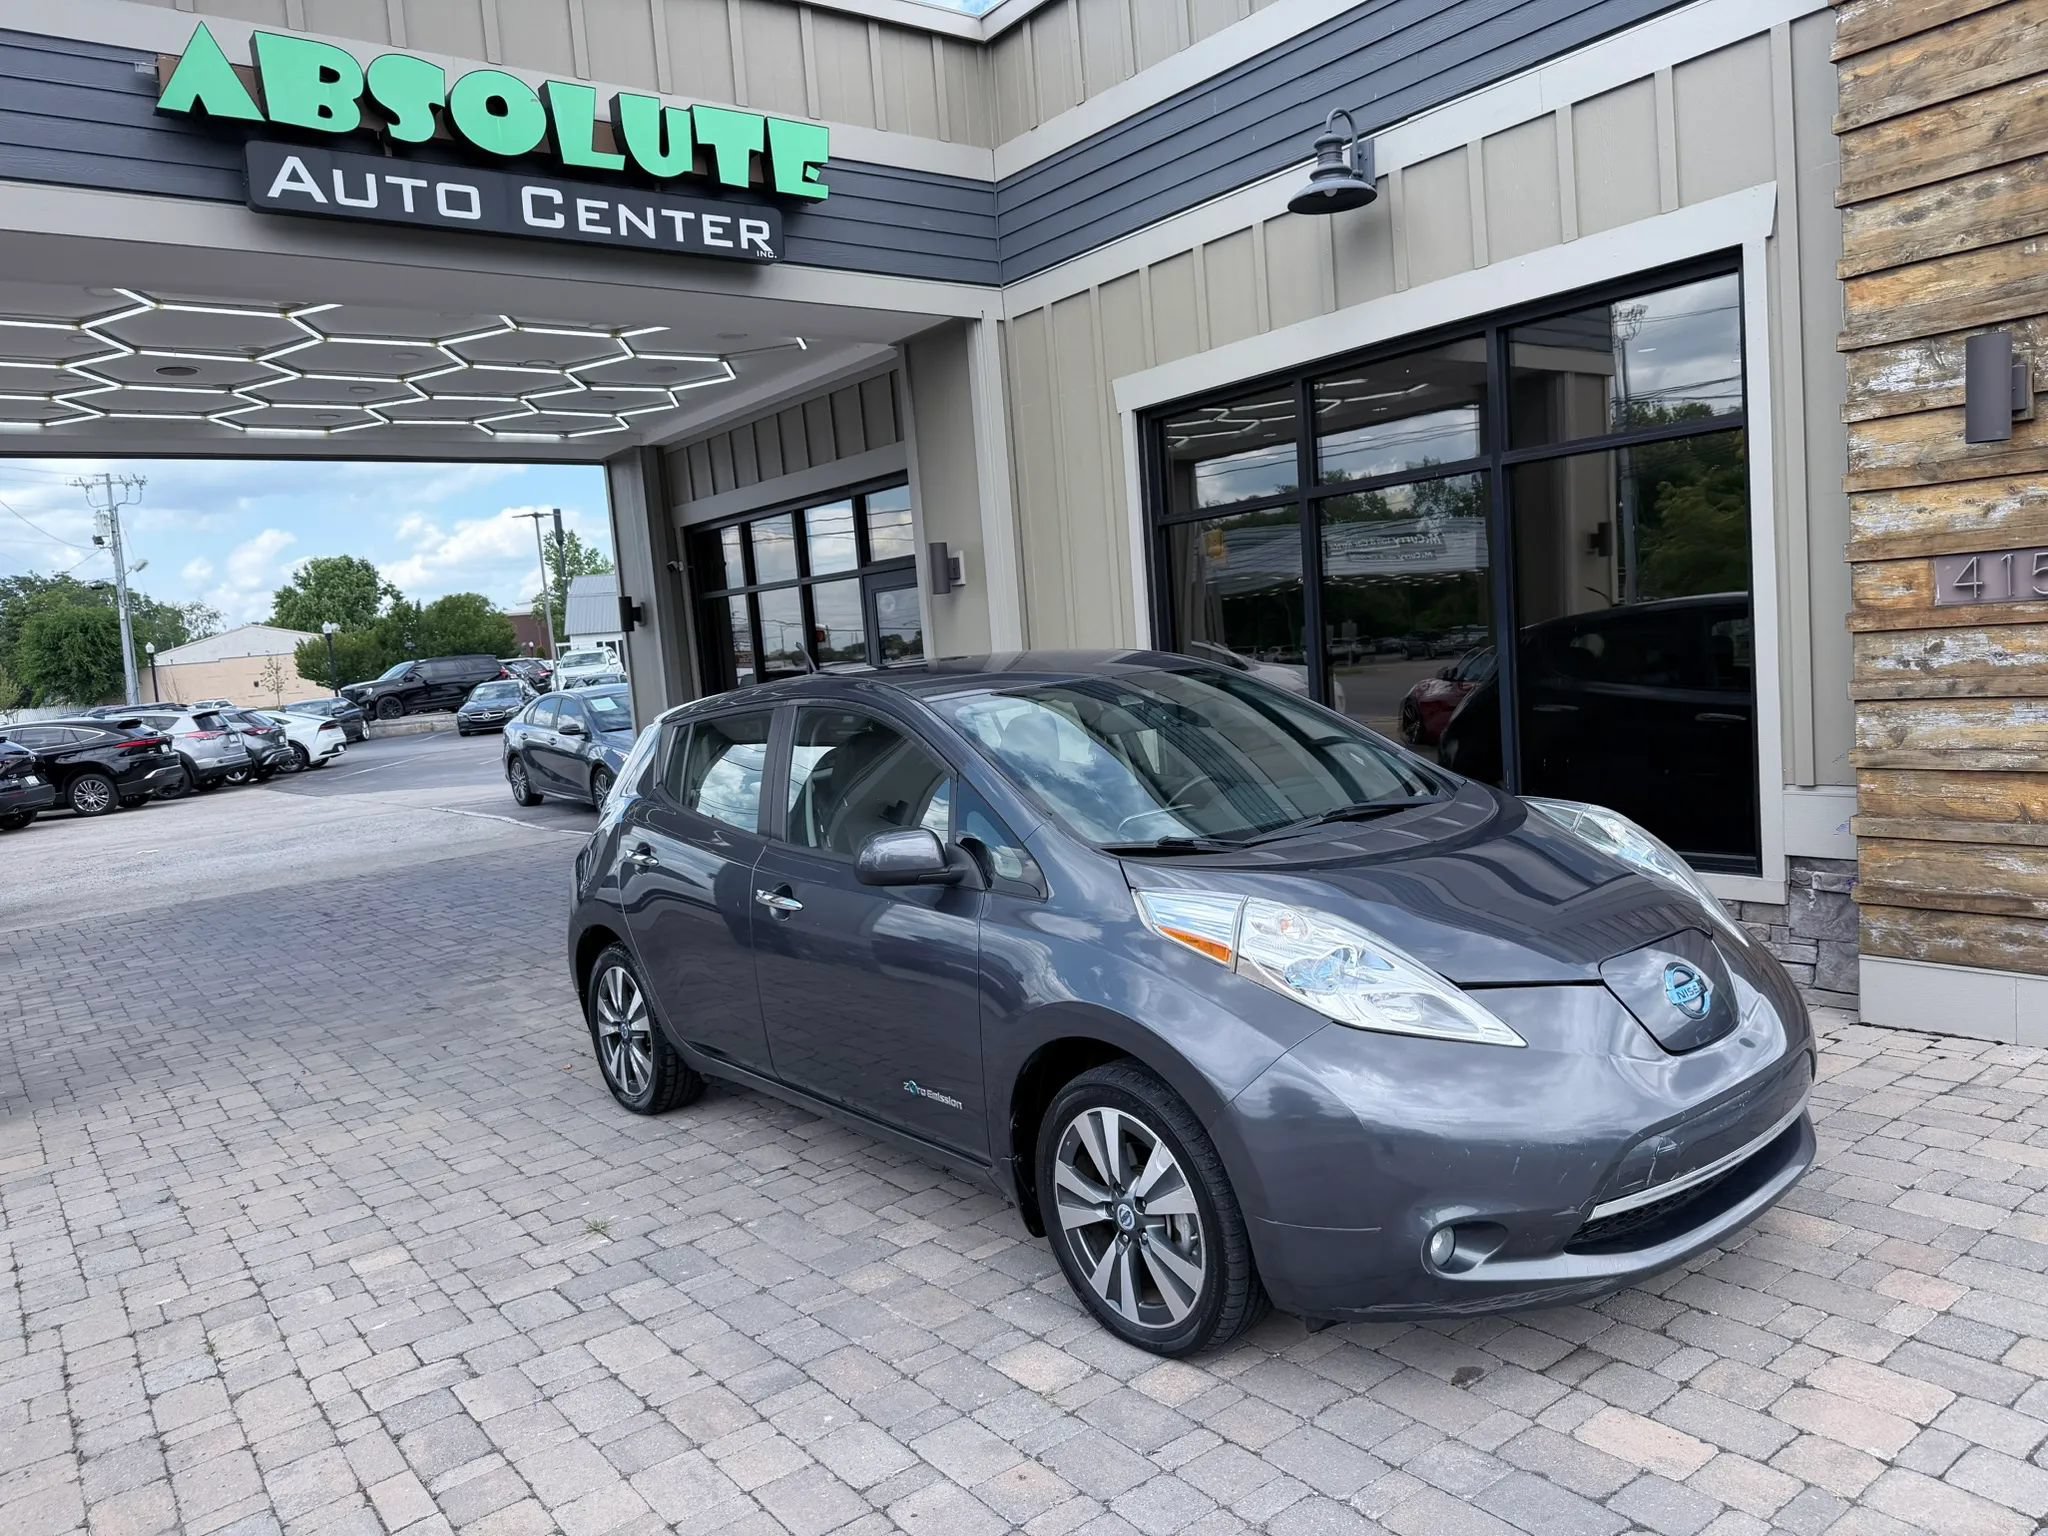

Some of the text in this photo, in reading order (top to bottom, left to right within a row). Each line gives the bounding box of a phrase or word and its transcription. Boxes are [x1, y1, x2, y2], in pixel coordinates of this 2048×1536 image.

[155, 21, 830, 201] ABSOLUTE
[267, 155, 774, 252] AUTO CENTER
[756, 250, 778, 258] INC.
[1952, 551, 2048, 599] 415
